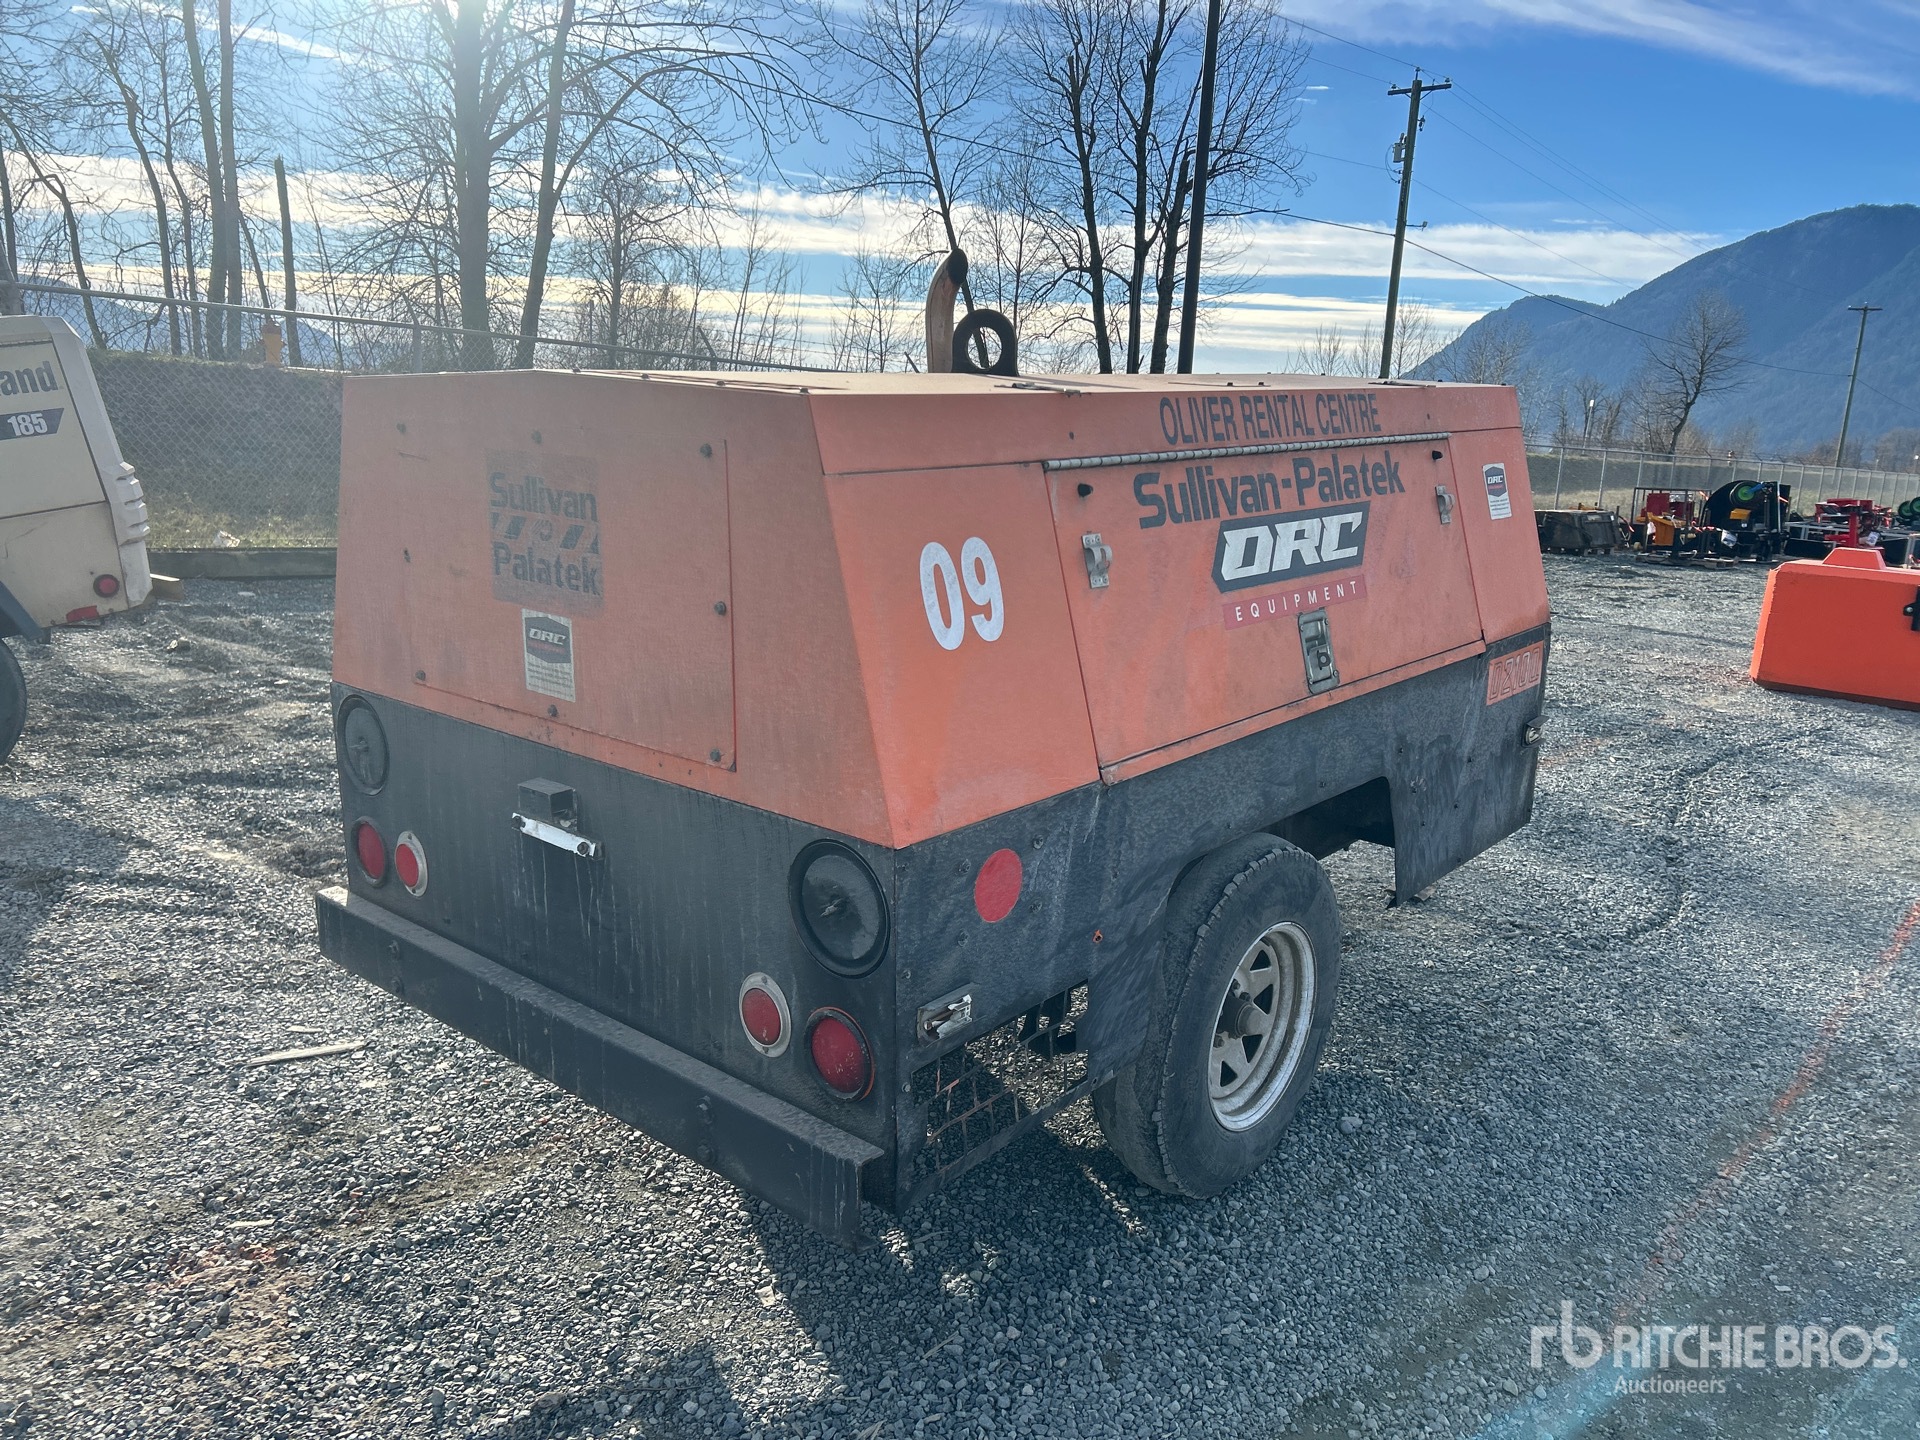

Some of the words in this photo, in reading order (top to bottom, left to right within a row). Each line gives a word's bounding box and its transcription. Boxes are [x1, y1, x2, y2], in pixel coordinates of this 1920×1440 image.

[7, 412, 48, 436] 185
[1159, 396, 1238, 445] OLIVER
[1240, 394, 1314, 439] RENTAL
[1315, 393, 1382, 435] CENTRE
[489, 471, 599, 522] Sullivan
[1133, 450, 1406, 529] Sullivan-Palatek
[492, 540, 601, 596] Palatek
[919, 536, 1005, 651] 09
[1235, 580, 1358, 622] EQUIPMENT
